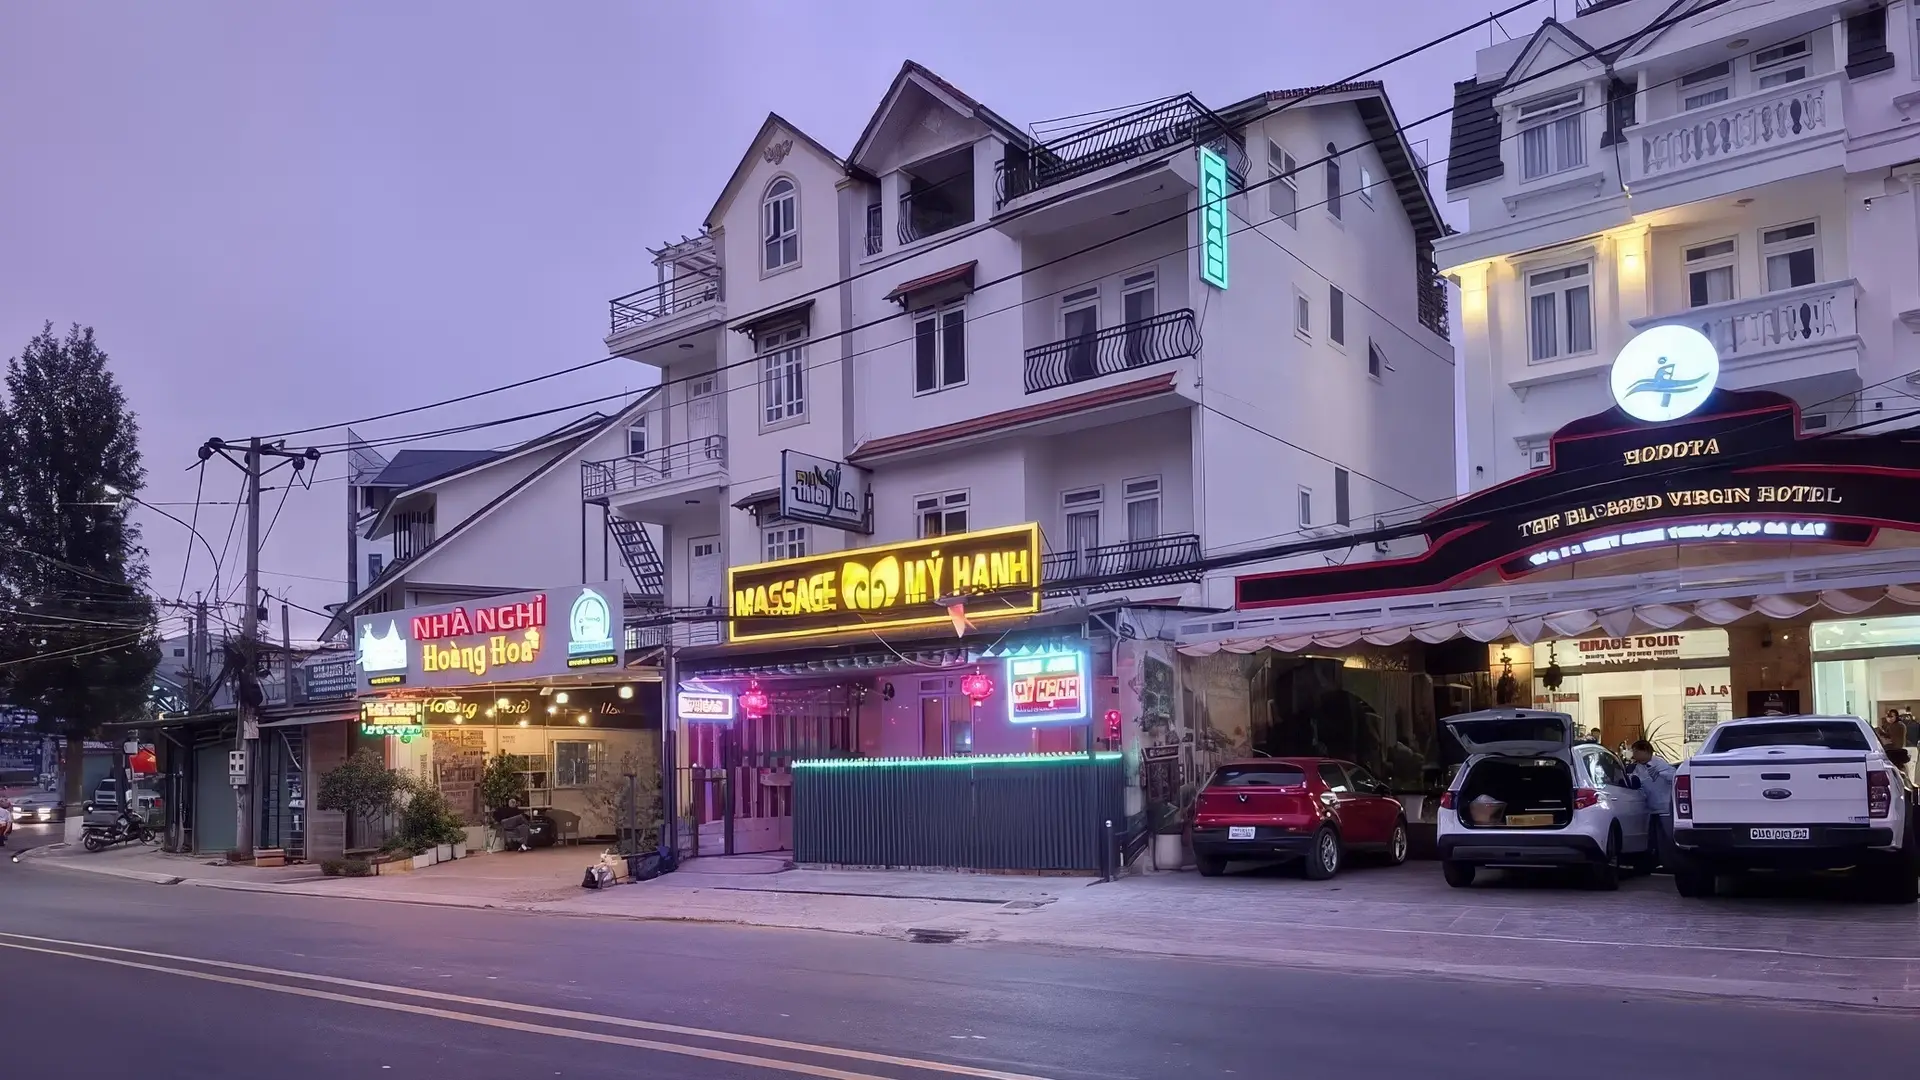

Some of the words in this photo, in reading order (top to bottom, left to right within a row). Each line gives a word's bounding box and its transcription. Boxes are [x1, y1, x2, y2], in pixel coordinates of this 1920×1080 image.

[1667, 487, 1750, 507] VIRGIN
[735, 570, 837, 616] MASSAGE
[412, 607, 473, 641] NHÀ
[476, 593, 546, 634] NGHỈ
[423, 640, 487, 676] Hoàng
